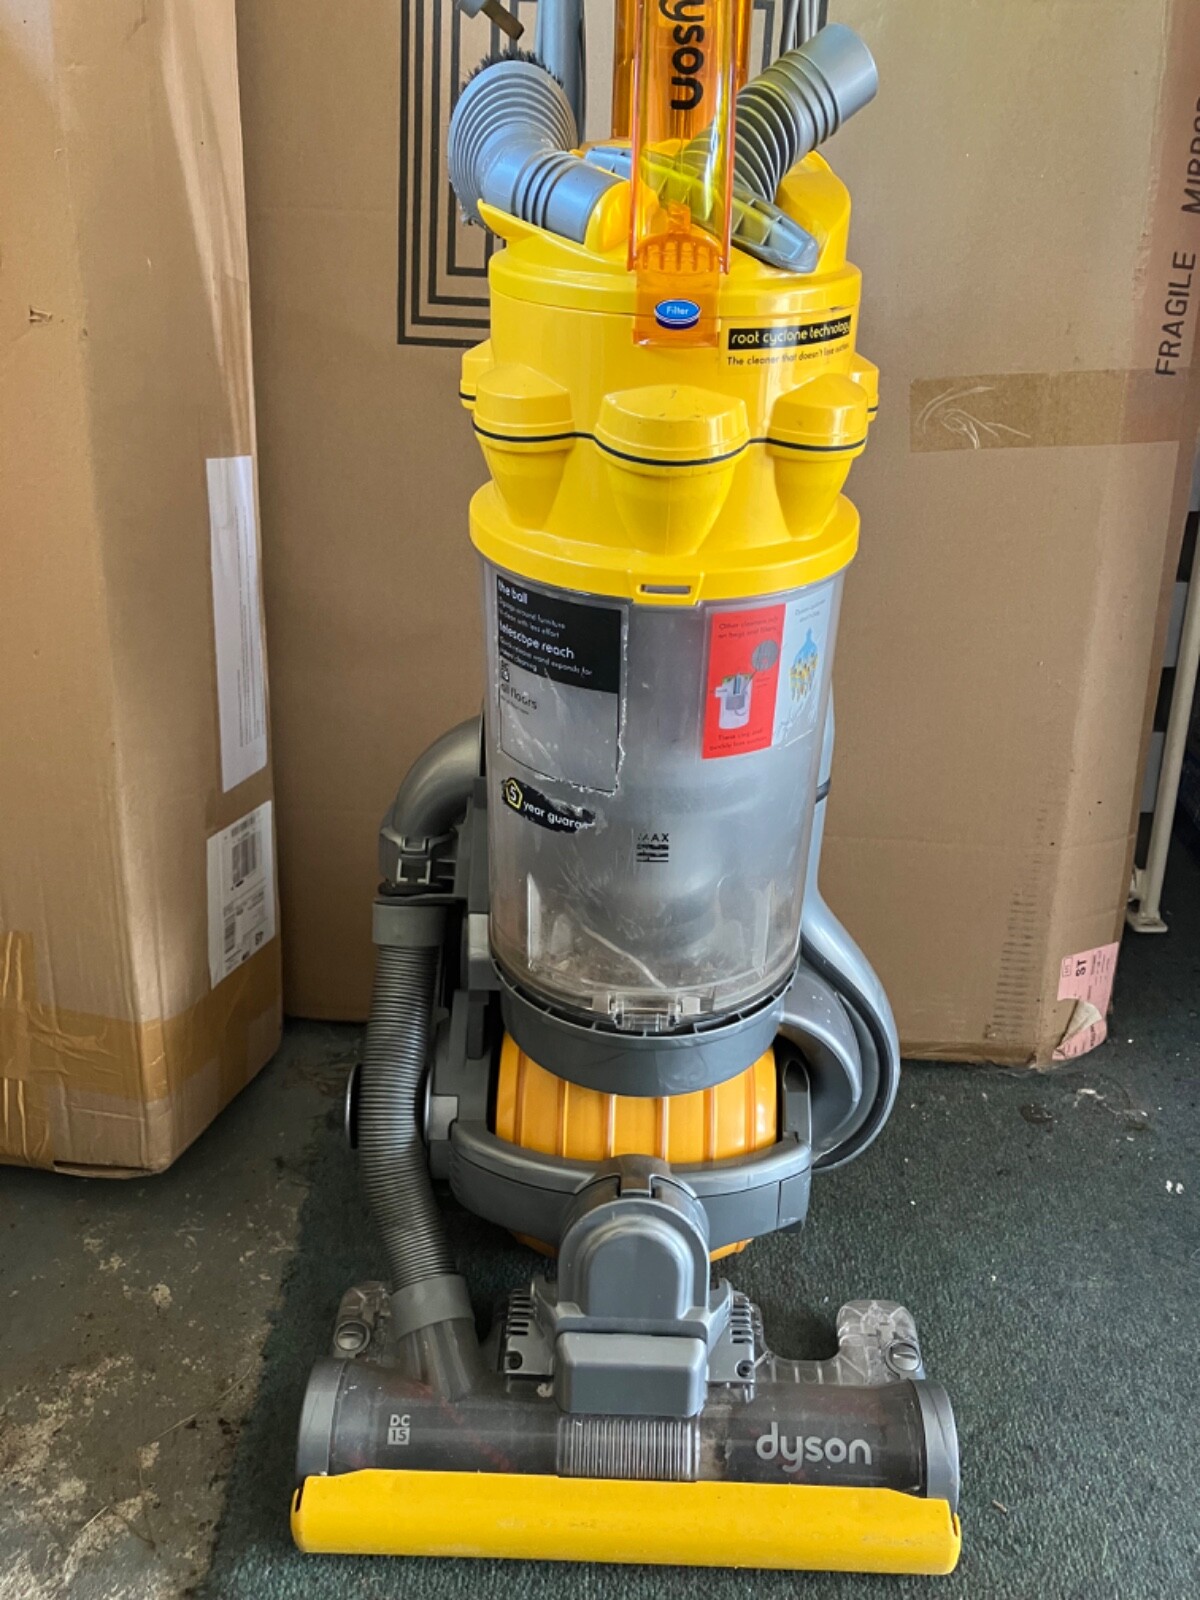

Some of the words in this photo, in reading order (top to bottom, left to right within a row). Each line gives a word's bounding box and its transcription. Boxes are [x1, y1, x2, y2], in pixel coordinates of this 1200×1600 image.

[659, 0, 705, 110] yson
[666, 305, 689, 315] Filter
[1155, 251, 1196, 376] FRAGILE
[731, 330, 760, 344] root
[762, 327, 808, 346] cyclone
[810, 321, 850, 339] technology
[728, 356, 744, 366] The
[747, 354, 780, 366] cleaner
[511, 586, 528, 605] ball
[499, 620, 541, 649] telescope
[541, 642, 575, 660] reach
[523, 800, 546, 818] year
[547, 812, 588, 830] guara
[390, 1413, 411, 1427] DC
[391, 1429, 407, 1442] 15
[756, 1421, 873, 1474] dyson
